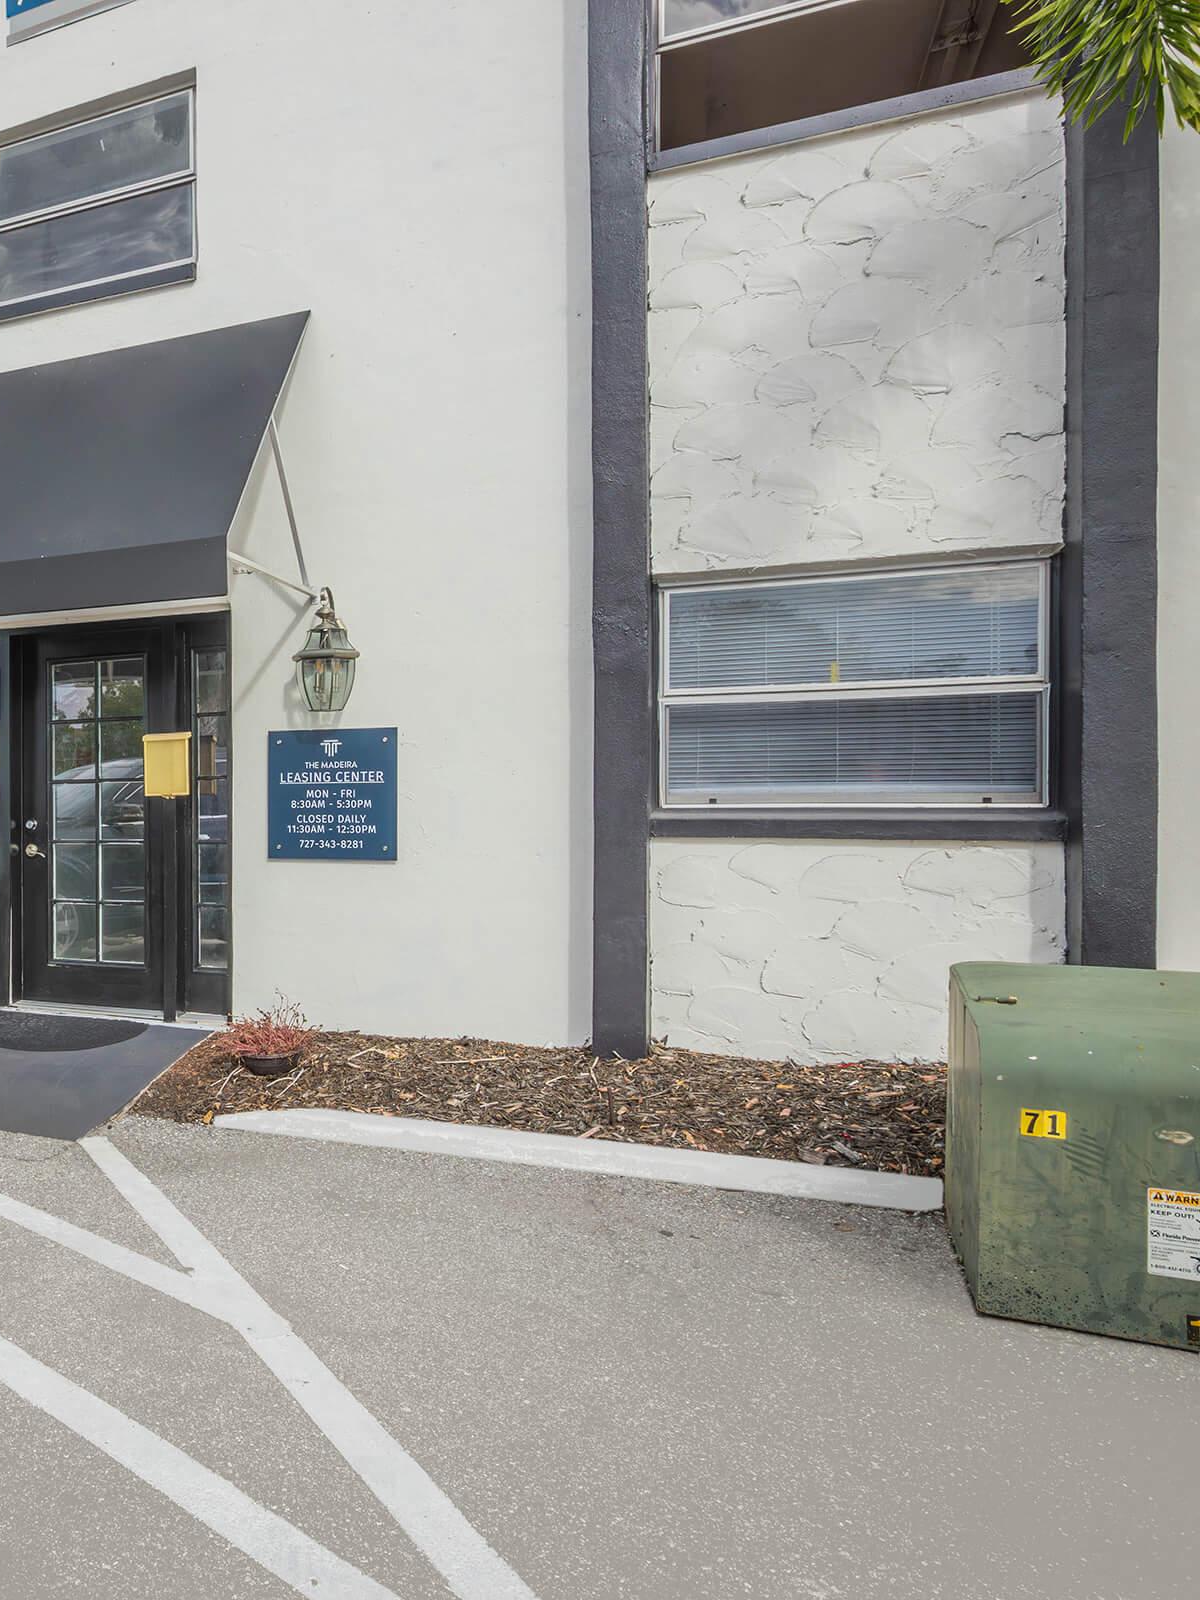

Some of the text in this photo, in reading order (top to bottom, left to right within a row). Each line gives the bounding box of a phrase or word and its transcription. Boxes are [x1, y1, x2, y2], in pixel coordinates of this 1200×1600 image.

[321, 760, 358, 769] MADEIRA
[280, 770, 384, 784] LEASING CENTER
[306, 789, 329, 798] MON
[340, 789, 356, 798] FRI
[290, 800, 326, 808] 8:30AM
[336, 800, 372, 808] 5:30PM
[296, 814, 367, 824] CLOSED DAILY
[287, 825, 325, 834] 11:30AM
[336, 824, 377, 834] 12:30PM
[299, 840, 364, 848] 727-343-8281
[1025, 1112, 1060, 1136] 71
